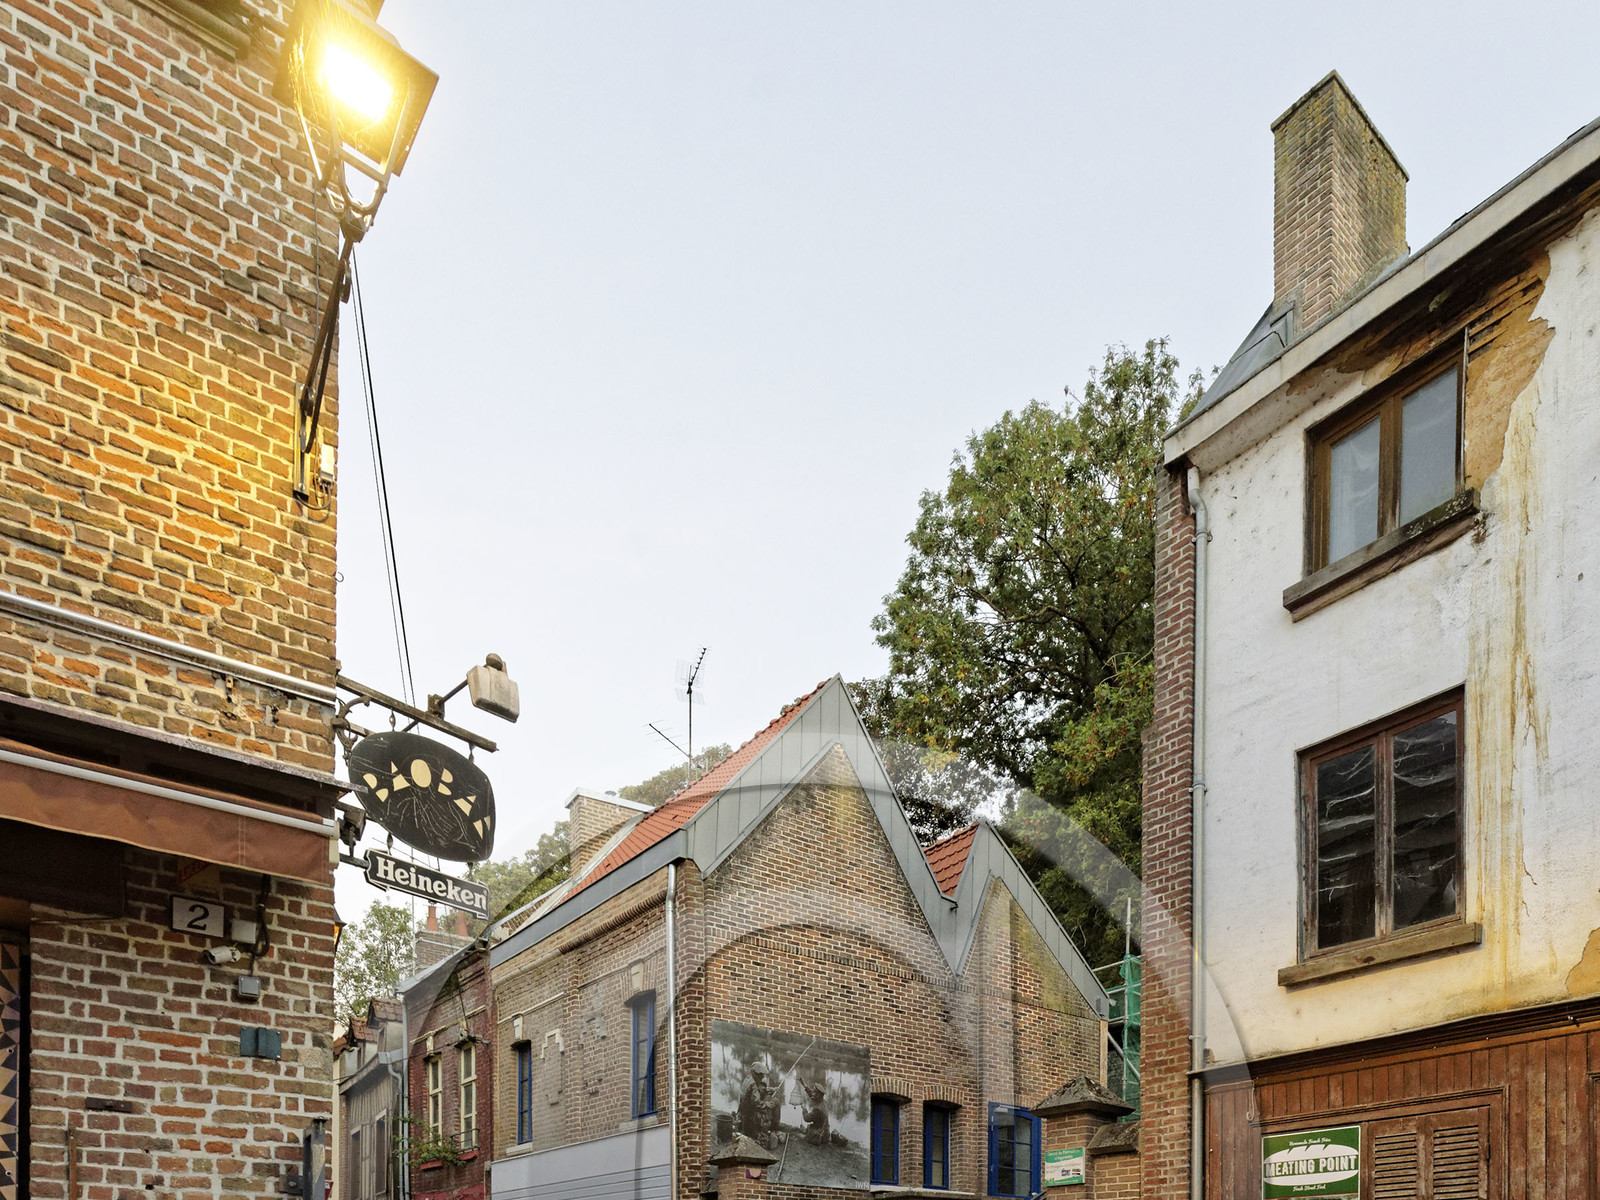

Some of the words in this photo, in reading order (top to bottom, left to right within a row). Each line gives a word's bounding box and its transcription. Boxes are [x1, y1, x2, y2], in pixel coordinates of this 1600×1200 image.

[376, 856, 488, 911] Heineken
[186, 903, 210, 931] 2
[1265, 1159, 1315, 1177] MEATING
[1319, 1155, 1357, 1172] POINT
